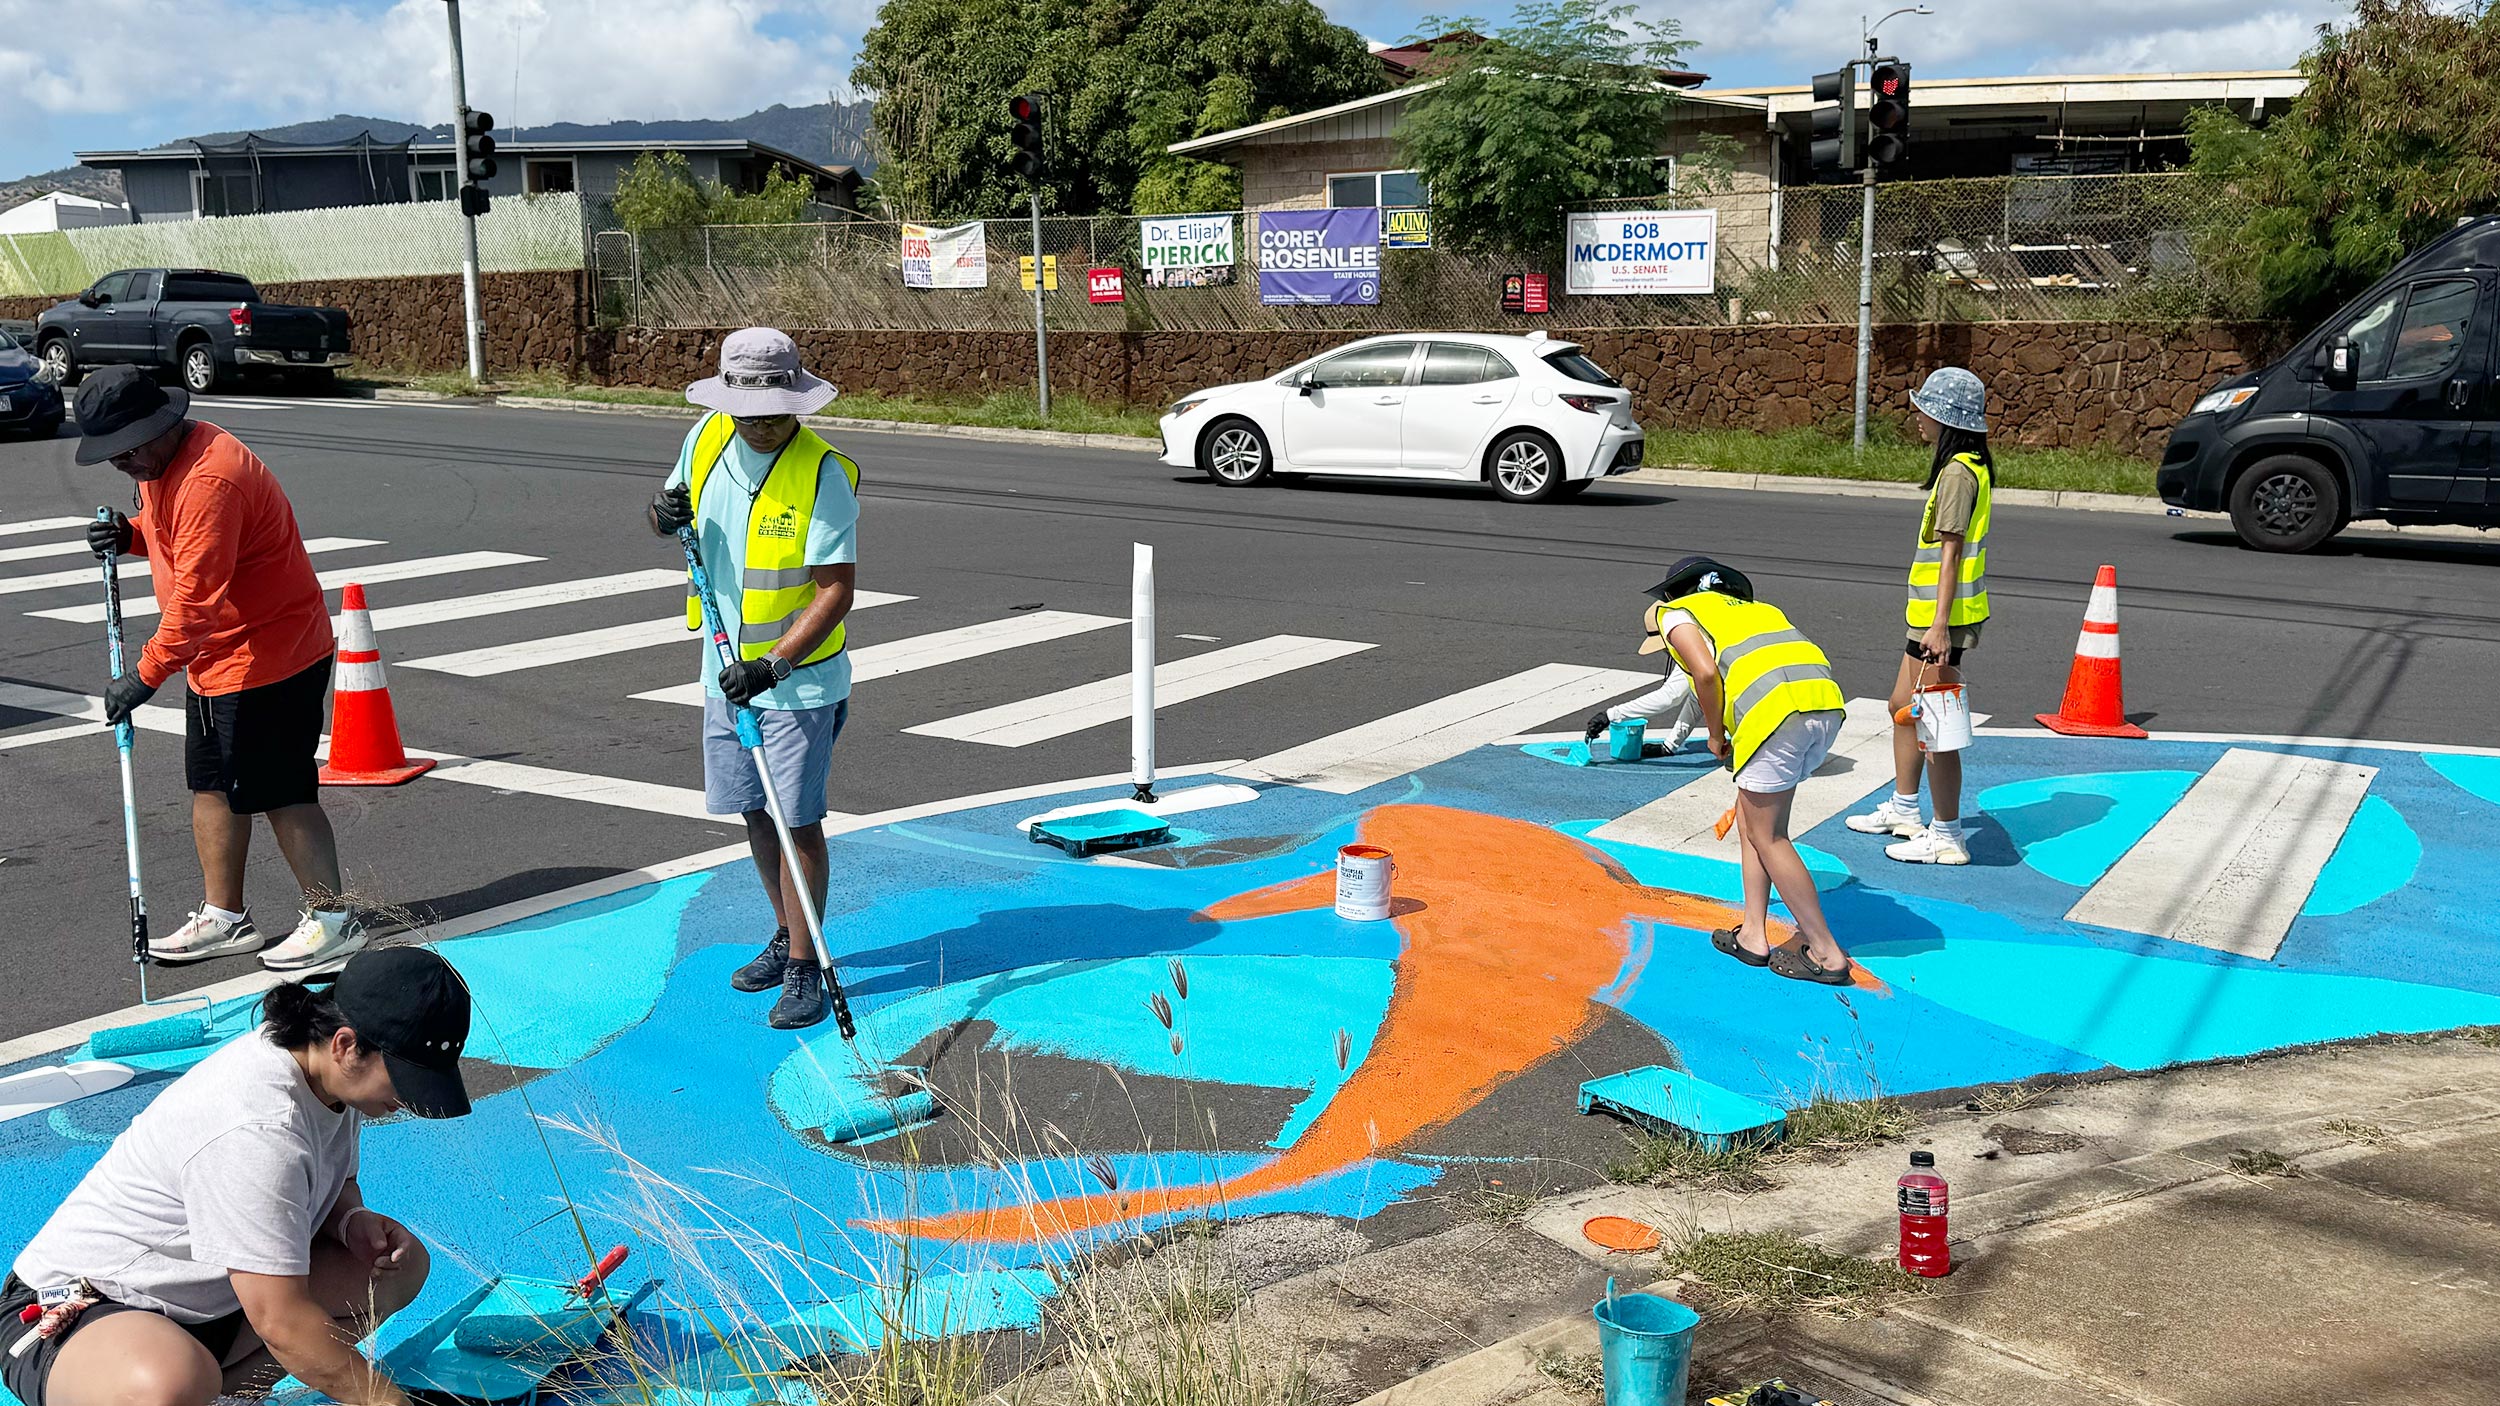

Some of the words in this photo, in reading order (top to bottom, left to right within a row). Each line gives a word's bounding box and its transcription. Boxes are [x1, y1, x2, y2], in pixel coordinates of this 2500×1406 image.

[1390, 212, 1428, 232] AQUINO
[1623, 223, 1659, 239] BOB
[1151, 226, 1173, 241] Dr.
[1178, 222, 1224, 243] Elijah
[1260, 229, 1328, 248] COREY
[903, 239, 931, 258] JESUS
[1147, 242, 1229, 266] PIERICK
[1261, 246, 1377, 269] ROSENLEE
[1574, 242, 1708, 262] MCDERMOTT
[1333, 271, 1352, 279] STATE
[1353, 271, 1377, 279] HOUSE
[1612, 265, 1630, 274] U.S.
[1632, 265, 1668, 274] SENATE
[1091, 277, 1121, 291] LAM
[1362, 285, 1373, 297] D
